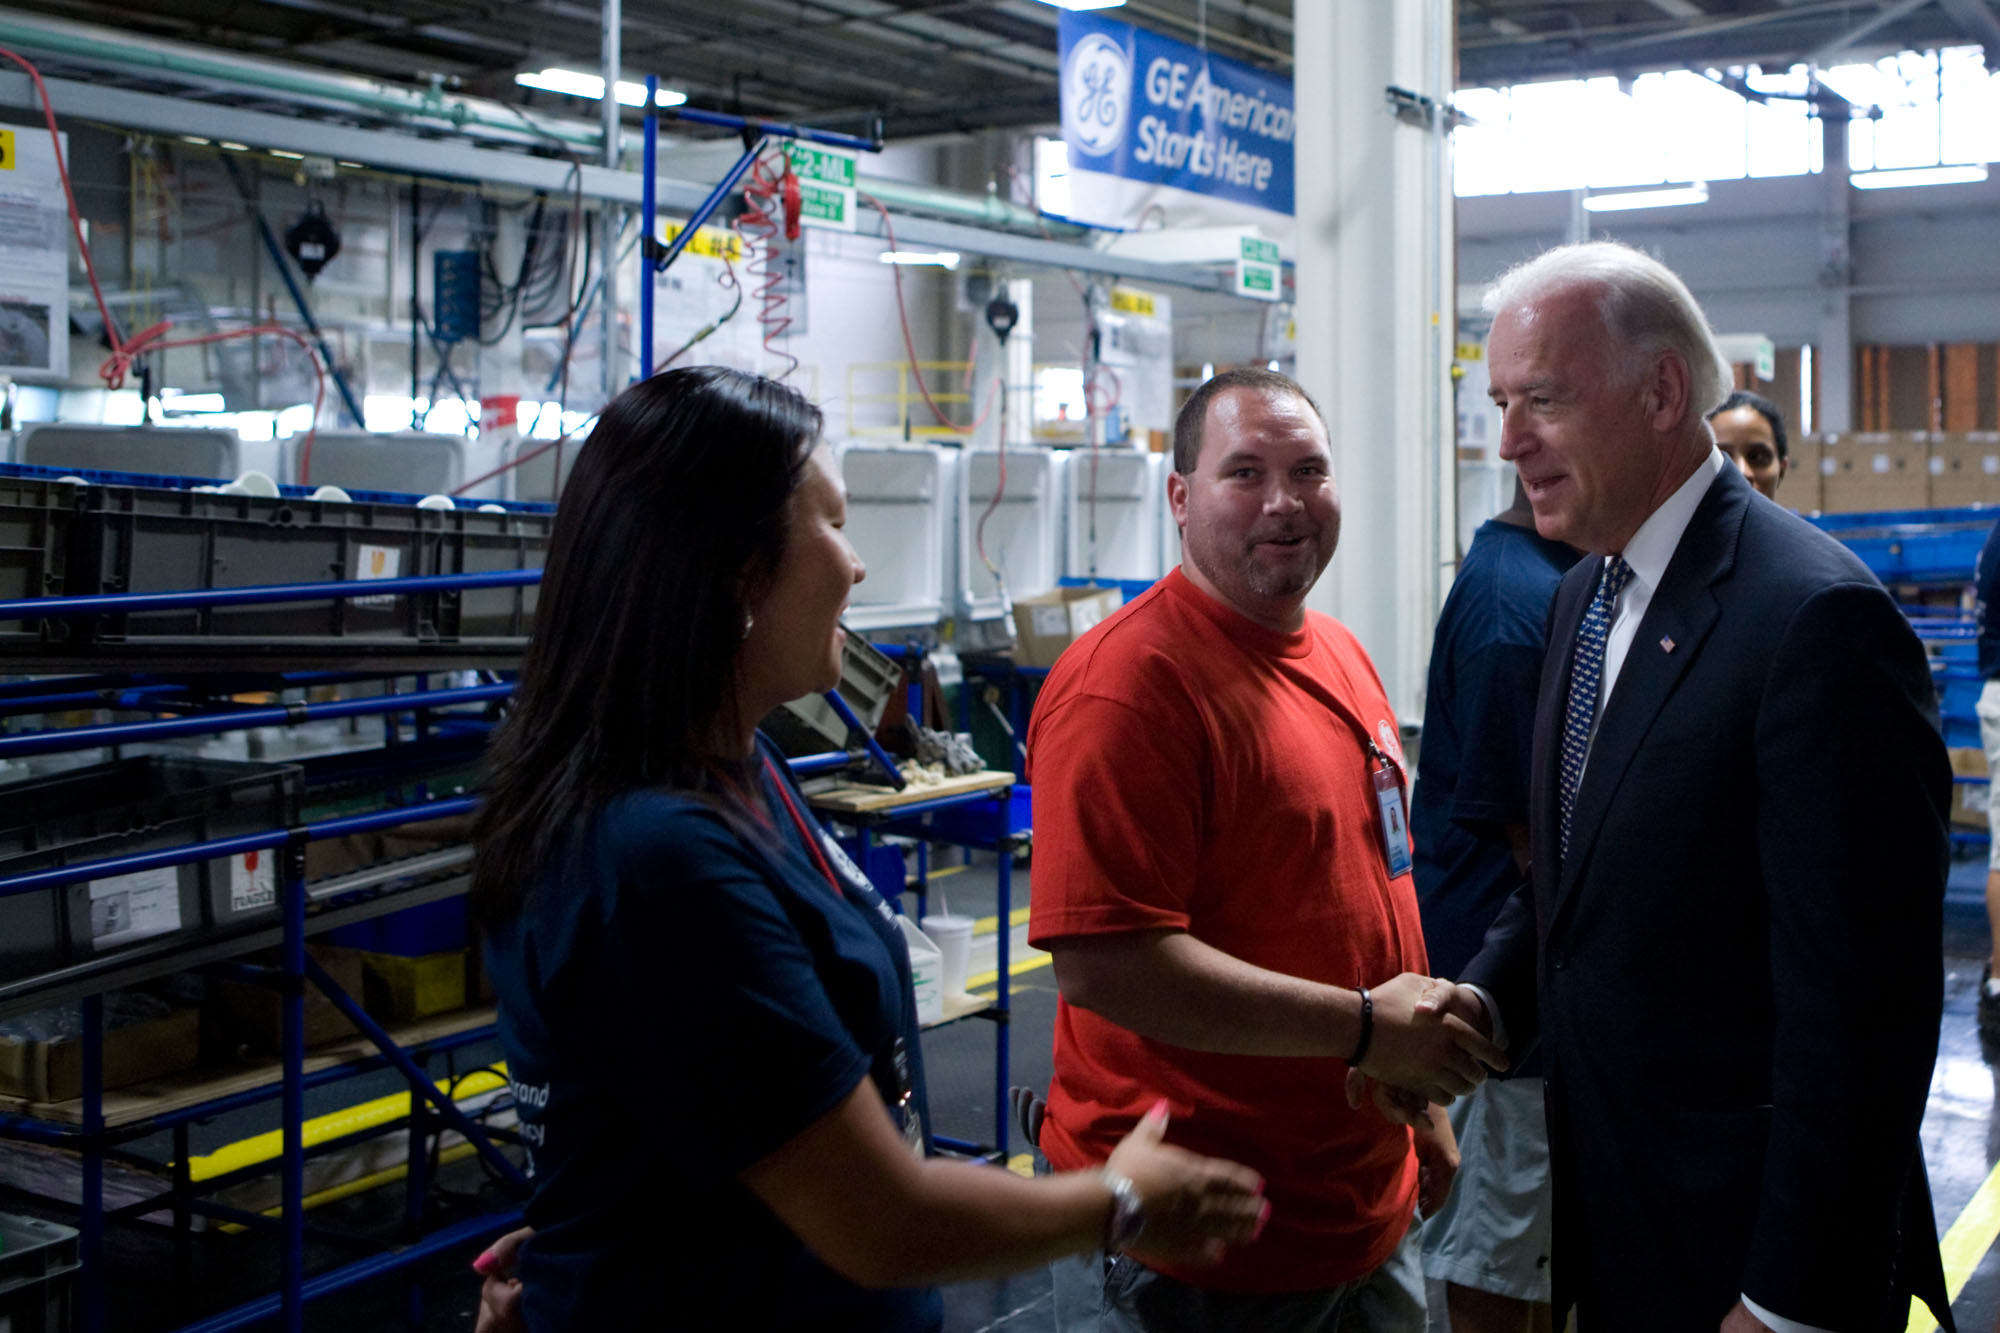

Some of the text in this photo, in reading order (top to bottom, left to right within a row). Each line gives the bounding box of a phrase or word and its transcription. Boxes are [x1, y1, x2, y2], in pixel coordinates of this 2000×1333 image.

[1145, 56, 1189, 110] GE
[1134, 114, 1273, 191] Starts Here
